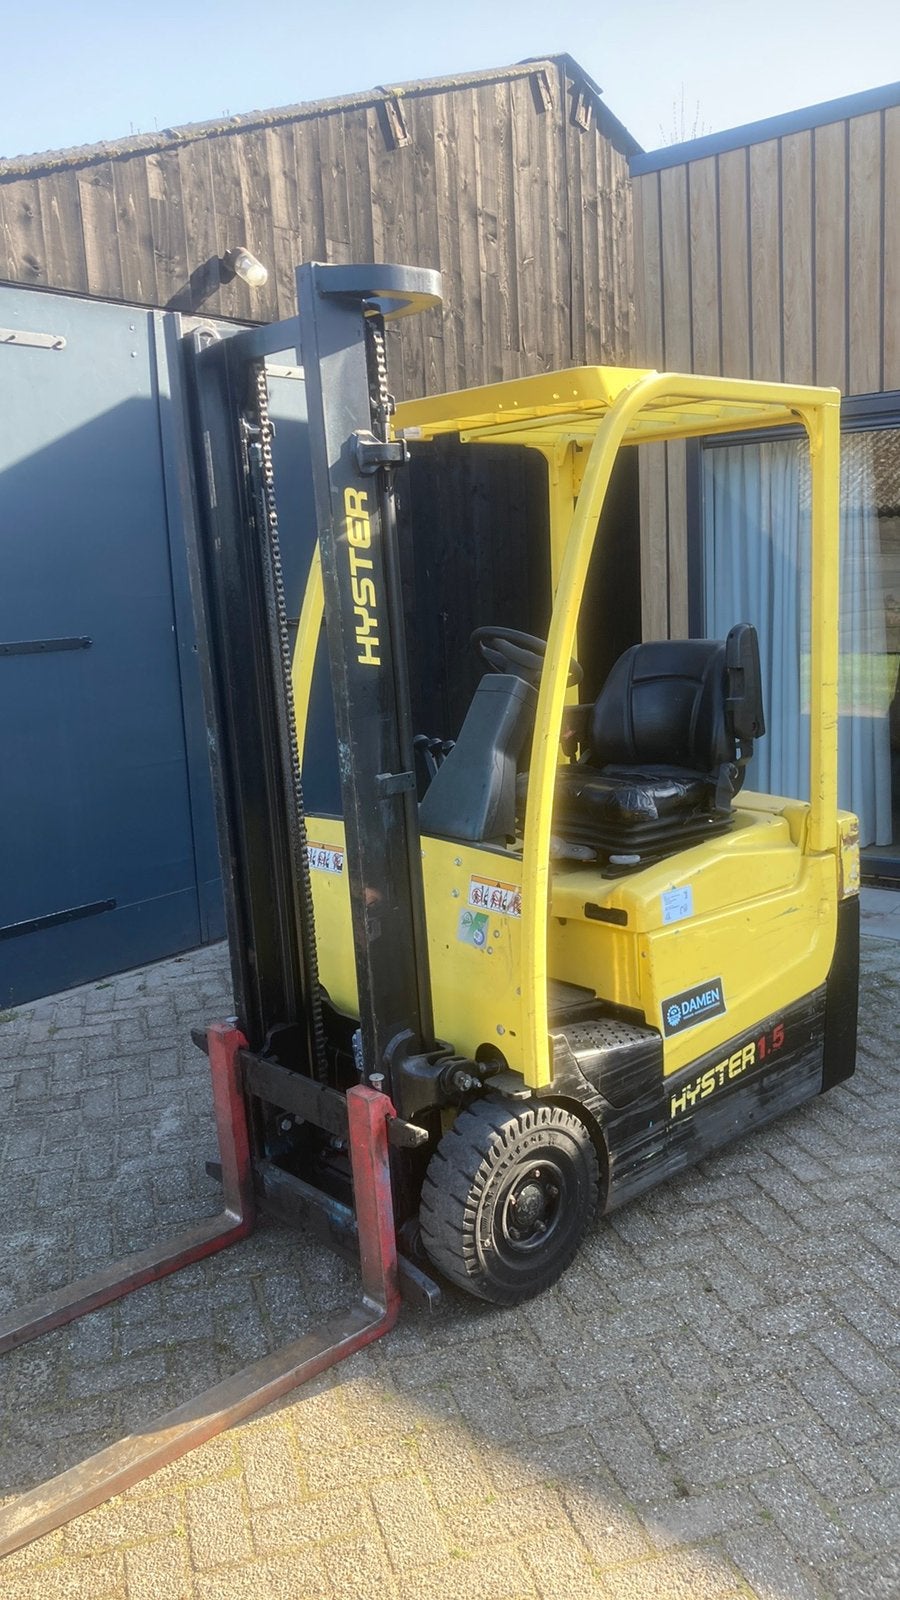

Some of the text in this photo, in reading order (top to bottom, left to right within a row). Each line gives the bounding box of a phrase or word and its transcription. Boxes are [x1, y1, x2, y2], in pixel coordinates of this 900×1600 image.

[344, 487, 381, 666] HYSTER
[681, 987, 720, 1016] DAMEN
[670, 1023, 785, 1119] HYSTER 1.5
